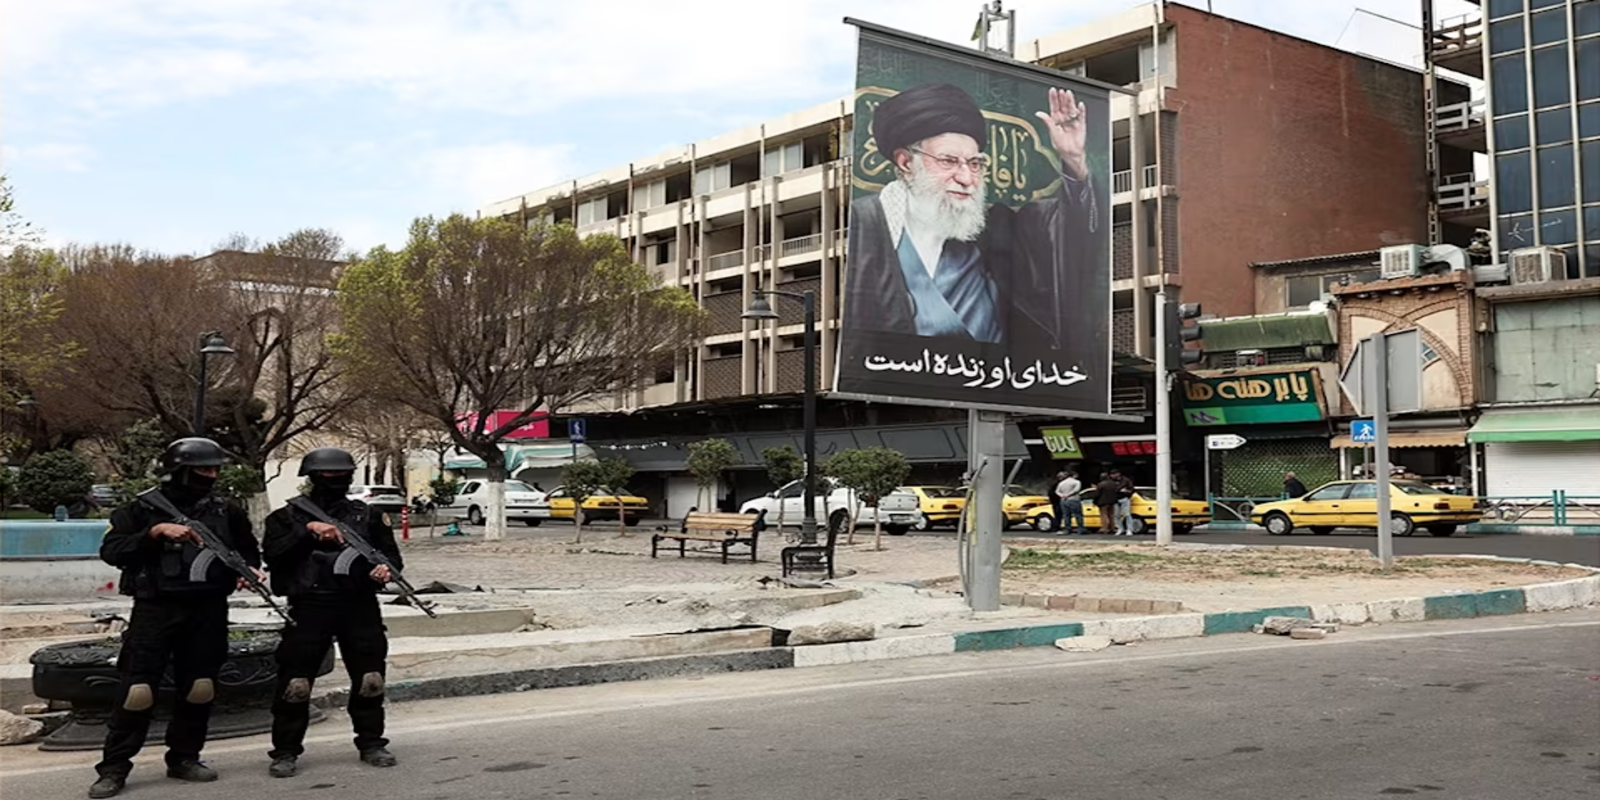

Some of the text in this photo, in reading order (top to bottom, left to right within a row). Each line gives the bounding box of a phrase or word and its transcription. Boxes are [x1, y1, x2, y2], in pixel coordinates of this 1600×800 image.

[864, 348, 1087, 389] خدای او زنده است
